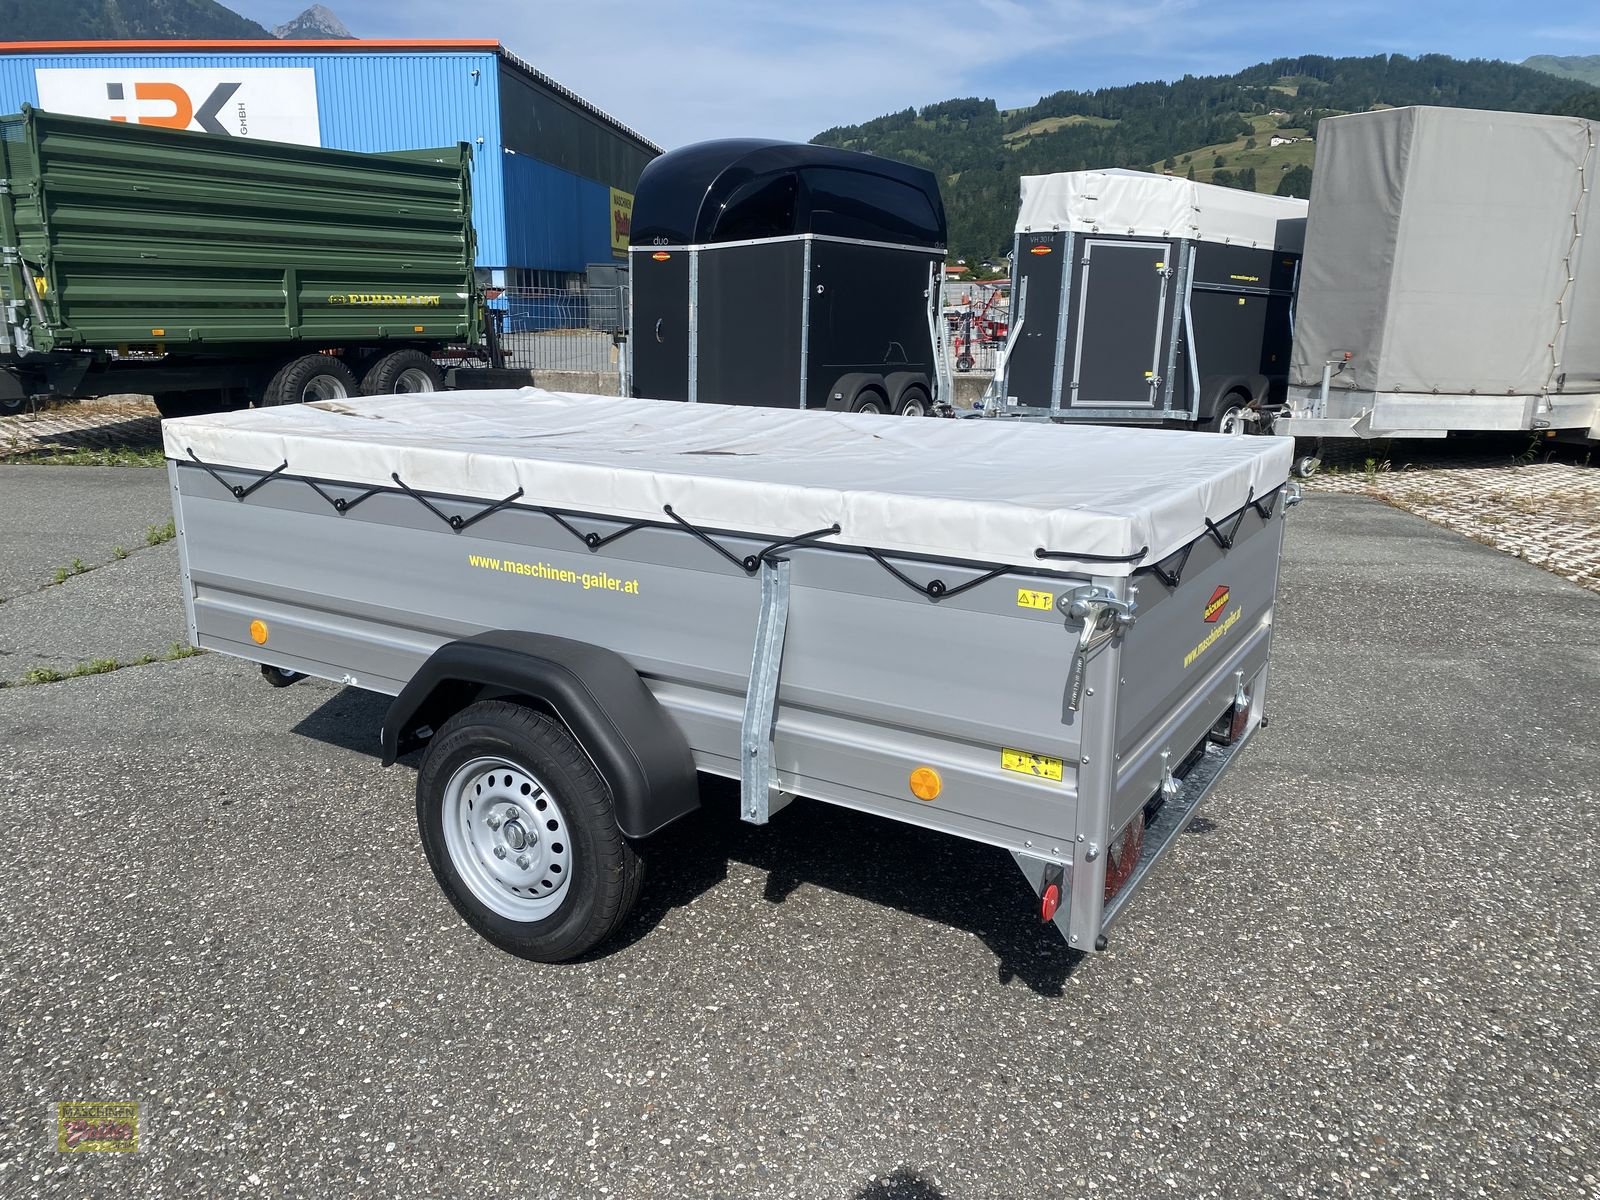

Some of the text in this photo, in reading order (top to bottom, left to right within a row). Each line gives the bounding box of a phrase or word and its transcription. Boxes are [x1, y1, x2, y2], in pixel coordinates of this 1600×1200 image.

[238, 102, 248, 136] GMBH
[653, 236, 669, 246] duo
[1040, 235, 1054, 243] 3014
[348, 294, 440, 304] FUHRMANN
[468, 554, 639, 595] www.maschinen-gailer.at
